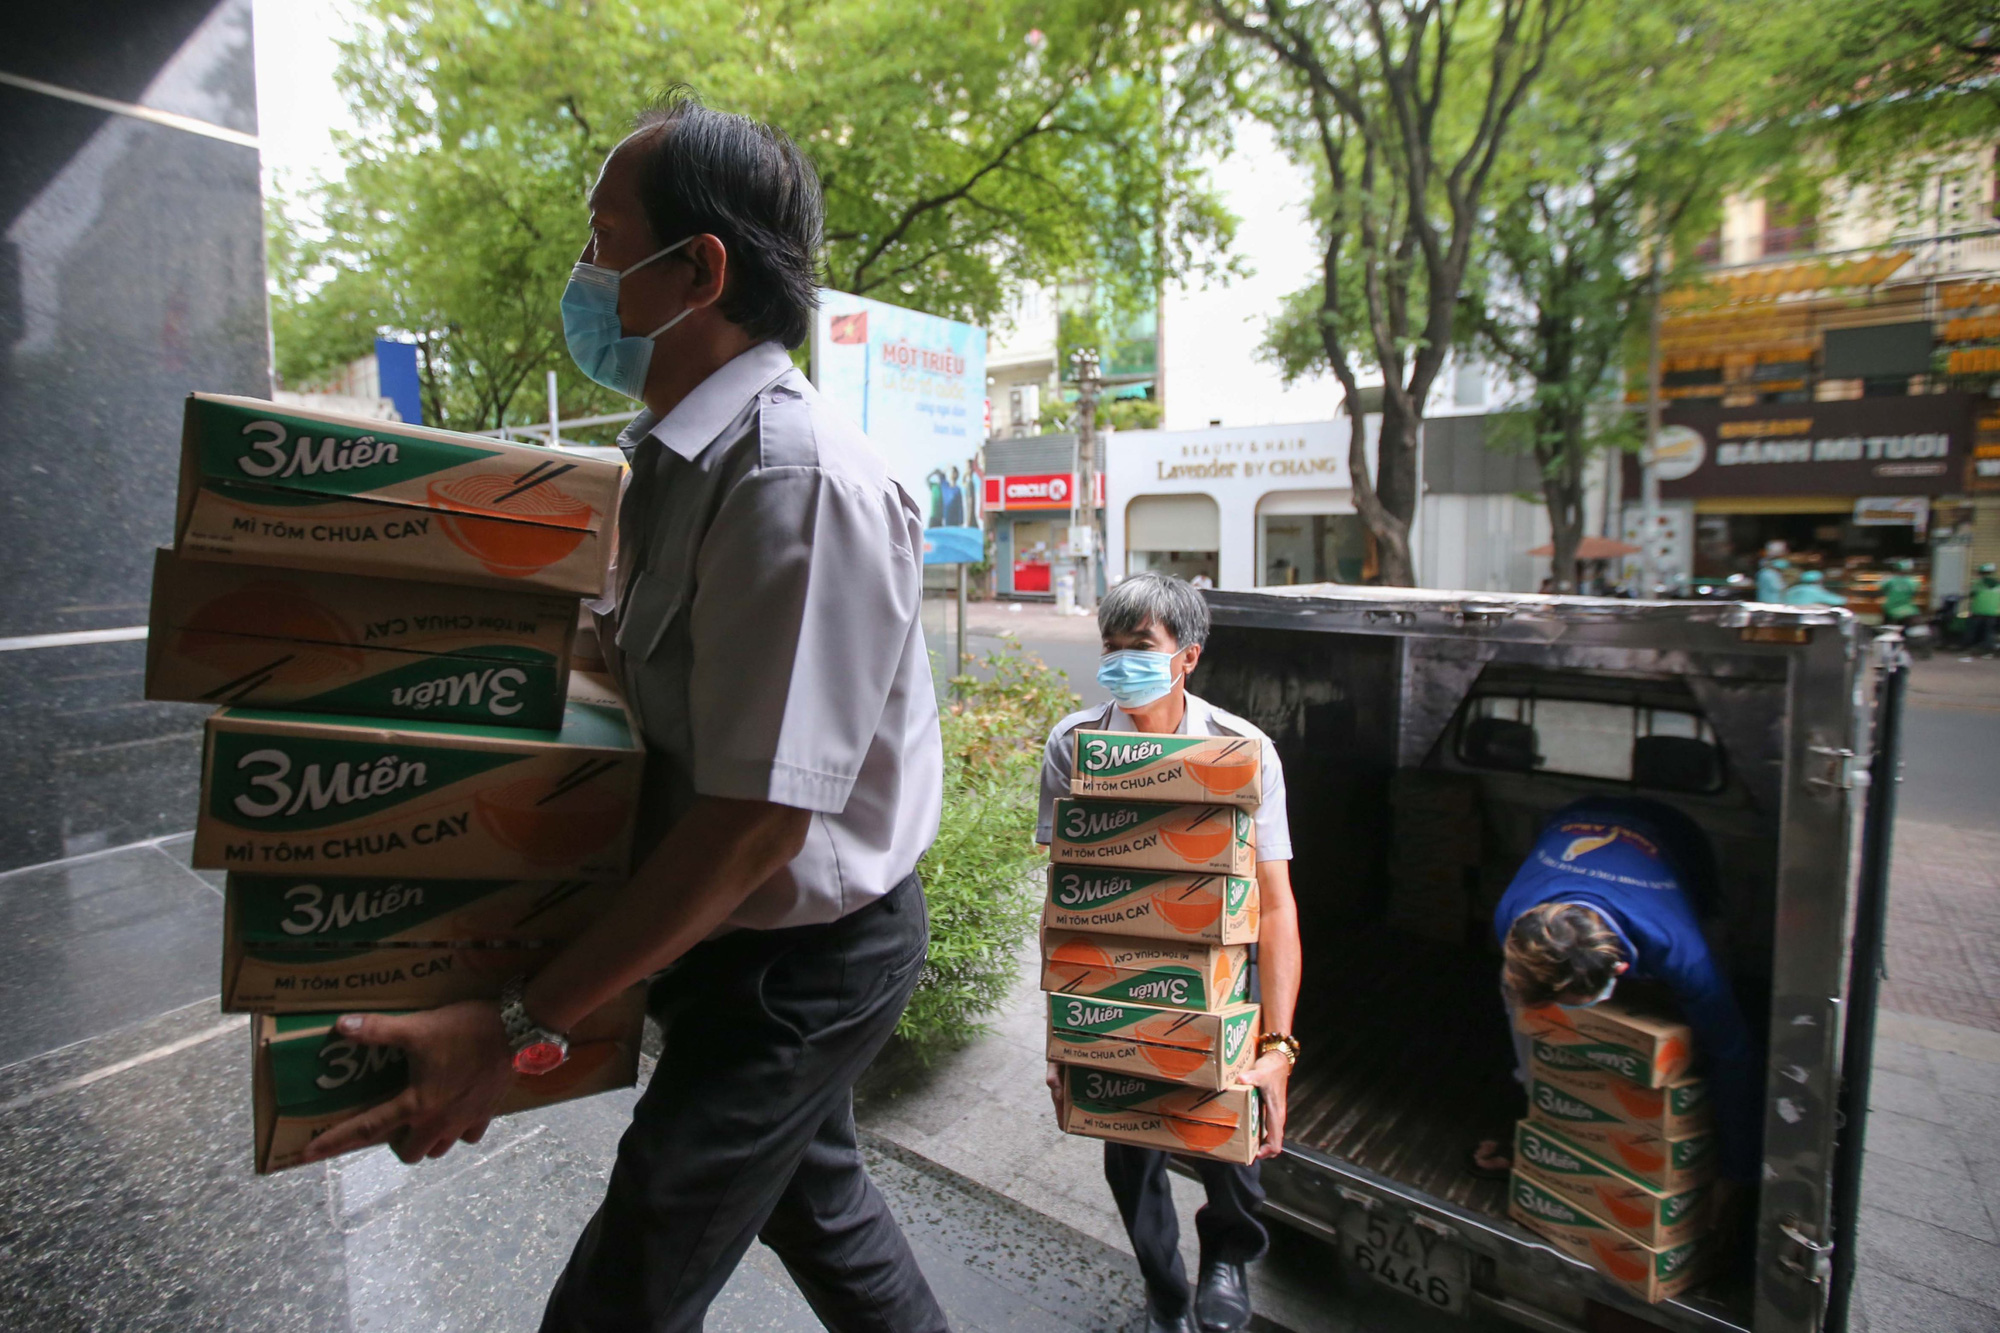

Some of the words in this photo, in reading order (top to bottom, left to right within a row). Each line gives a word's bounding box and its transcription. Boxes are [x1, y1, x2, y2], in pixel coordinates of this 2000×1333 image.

[883, 338, 918, 372] MỘT
[922, 347, 965, 379] TRIỆU
[1182, 441, 1244, 456] BEAUTY
[1266, 437, 1307, 451] HAIR
[1157, 458, 1237, 481] Lavender
[1244, 462, 1265, 477] BY
[1269, 457, 1336, 476] CHANG
[1006, 483, 1049, 498] CIRCLE
[232, 517, 256, 534] MÌ
[263, 522, 304, 540] TÔM
[310, 525, 378, 542] CHUA
[384, 518, 430, 538] CAY
[364, 618, 408, 640] CAY
[414, 615, 474, 630] CHUA
[1083, 780, 1094, 791] MÌ
[1096, 781, 1118, 791] TÔM
[1120, 776, 1155, 790] CHUA
[1157, 767, 1183, 783] CAY
[225, 840, 254, 862] MÌ
[261, 841, 315, 862] TÔM
[321, 829, 407, 861] CHUA
[412, 812, 470, 847] CAY
[1061, 847, 1073, 857] MÌ
[1074, 847, 1095, 857] TÔM
[1097, 843, 1131, 857] CHUA
[1132, 834, 1158, 851] CAY
[1056, 915, 1067, 925] MÌ
[1069, 915, 1090, 925] TÔM
[1091, 910, 1125, 925] CHUA
[1126, 902, 1151, 919] CAY
[1114, 952, 1133, 964] CAY
[1134, 951, 1160, 960] CHUA
[345, 968, 407, 989] CHUA
[411, 955, 454, 979] CAY
[1091, 1049, 1116, 1060] CHUA
[1117, 1046, 1136, 1057] CAY
[1112, 1120, 1139, 1131] CHUA
[1141, 1119, 1161, 1131] CAY
[1354, 1245, 1450, 1306] 6446
